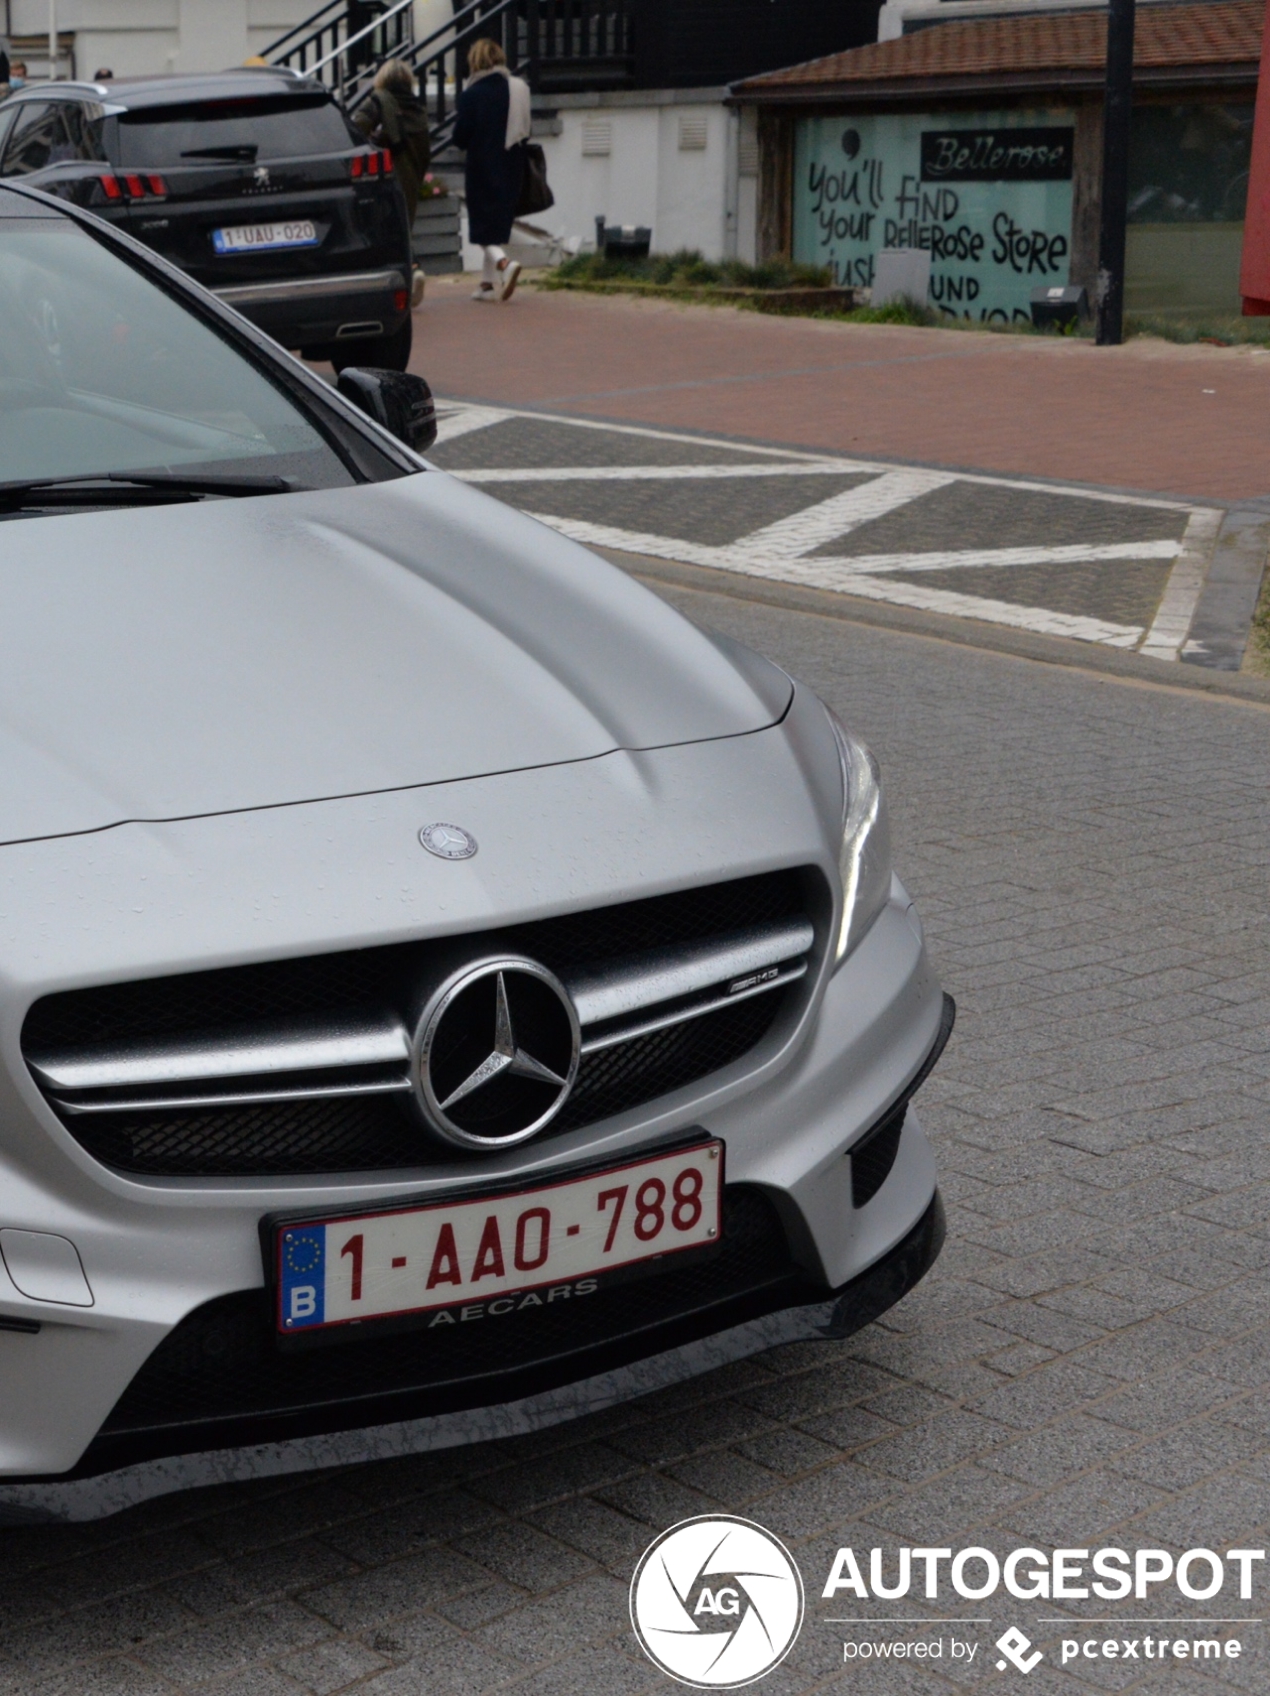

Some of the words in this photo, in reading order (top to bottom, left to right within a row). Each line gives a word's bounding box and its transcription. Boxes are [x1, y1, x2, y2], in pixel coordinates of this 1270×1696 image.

[925, 136, 1064, 175] Bellerose
[225, 223, 314, 247] 1-UAU-020
[291, 1285, 317, 1319] B
[340, 1168, 703, 1301] 1-AAO-788
[427, 1278, 599, 1328] AECARS
